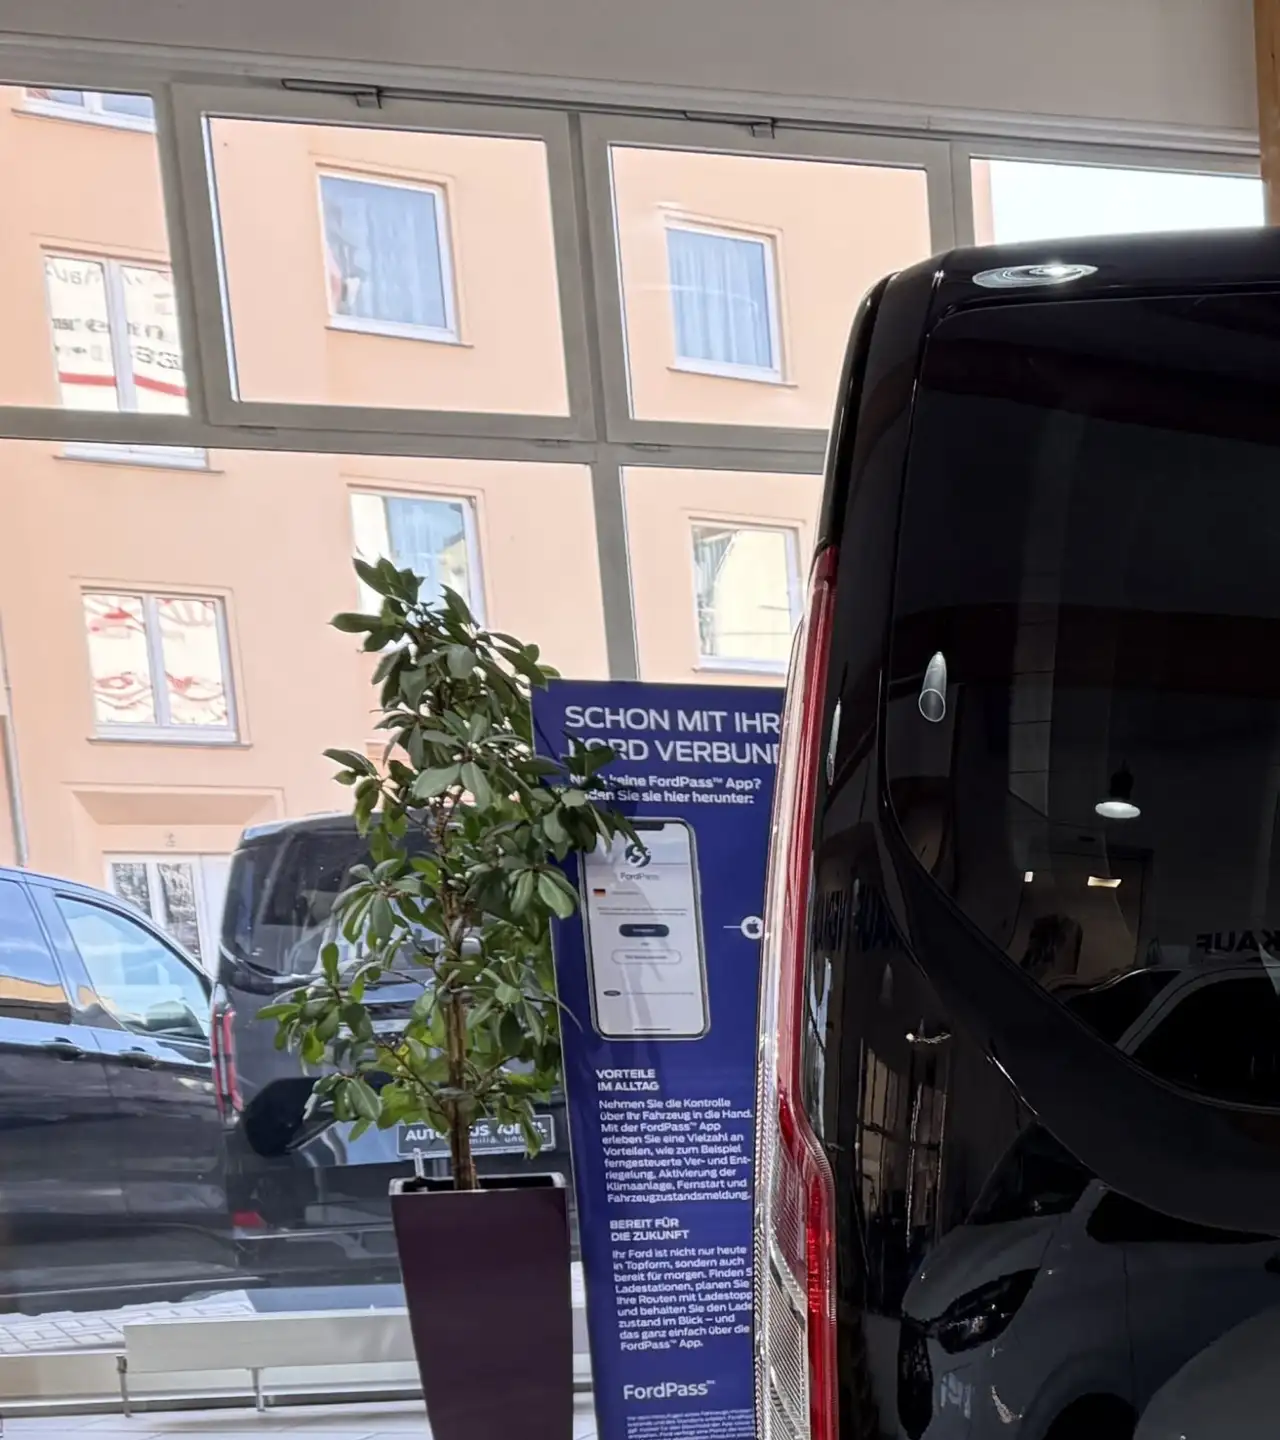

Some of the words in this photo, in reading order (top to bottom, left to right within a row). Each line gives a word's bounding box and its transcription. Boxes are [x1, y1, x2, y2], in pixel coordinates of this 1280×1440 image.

[565, 705, 671, 731] SCHON
[677, 709, 728, 733] MIT
[734, 711, 780, 734] IHR
[725, 777, 762, 790] App?
[617, 790, 640, 801] Sie
[641, 790, 662, 802] sie
[664, 791, 690, 802] hier
[692, 791, 755, 804] herunter:
[596, 1069, 656, 1079] VORTEILE
[598, 1082, 612, 1091] IM
[614, 1082, 660, 1091] ALLTAG
[600, 1100, 645, 1109] Nehmen
[647, 1099, 663, 1108] Sie
[666, 1099, 680, 1108] die
[683, 1098, 731, 1108] Kontrolle
[600, 1111, 624, 1121] über
[627, 1111, 640, 1120] Ihr
[643, 1111, 691, 1121] Fahrzeug
[693, 1110, 702, 1119] in
[704, 1110, 720, 1119] die
[722, 1109, 753, 1118] Hand.
[405, 1125, 490, 1141] AUTUS
[602, 1124, 618, 1132] Mit
[621, 1123, 638, 1132] der
[700, 1122, 721, 1132] App
[602, 1135, 642, 1144] erleben
[645, 1134, 661, 1143] Sie
[663, 1134, 685, 1143] eine
[687, 1133, 728, 1142] Vielzahl
[730, 1134, 744, 1142] an
[604, 1147, 654, 1157] Vorteilen,
[656, 1146, 674, 1155] wie
[676, 1147, 699, 1155] zum
[701, 1144, 741, 1154] Beispiel
[604, 1158, 682, 1168] ferngesteuerte
[683, 1157, 705, 1166] Ver-
[707, 1156, 728, 1165] und
[730, 1156, 752, 1165] Ent-
[606, 1171, 656, 1181] riegelung,
[658, 1168, 717, 1179] Aktivierung
[720, 1168, 736, 1177] der
[607, 1181, 675, 1191] Klimaanlage,
[677, 1179, 725, 1189] Fernstart
[727, 1179, 747, 1188] und
[608, 1191, 751, 1203] Fahrzeugzustandsmeldung.
[610, 1219, 652, 1229] BEREIT
[655, 1216, 679, 1228] FÜR
[611, 1232, 631, 1241] DIE
[633, 1230, 689, 1241] ZUKUNFT
[613, 1250, 626, 1259] Ihr
[628, 1249, 652, 1258] Ford
[655, 1248, 668, 1257] ist
[670, 1247, 696, 1257] nicht
[698, 1248, 715, 1256] nur
[717, 1246, 747, 1255] heute
[613, 1262, 622, 1270] in
[625, 1260, 673, 1271] Topform,
[675, 1258, 717, 1268] sondern
[719, 1257, 744, 1266] auch
[614, 1273, 645, 1282] bereit
[647, 1272, 662, 1281] für
[664, 1271, 707, 1281] morgen.
[709, 1268, 744, 1278] Finden
[616, 1283, 693, 1294] Ladestationen,
[696, 1281, 731, 1291] planen
[733, 1280, 749, 1289] Sie
[617, 1296, 636, 1305] Ihre
[639, 1294, 677, 1304] Routen
[679, 1293, 696, 1302] mit
[618, 1307, 638, 1316] und
[640, 1306, 686, 1315] behalten
[689, 1304, 704, 1313] Sie
[707, 1303, 726, 1312] den
[619, 1318, 661, 1328] zustand
[663, 1317, 676, 1326] im
[678, 1316, 703, 1325] Blick
[715, 1314, 735, 1323] und
[620, 1331, 639, 1340] das
[641, 1329, 666, 1339] ganz
[669, 1327, 706, 1337] einfach
[709, 1325, 732, 1335] über
[734, 1324, 749, 1334] die
[680, 1339, 703, 1348] App.
